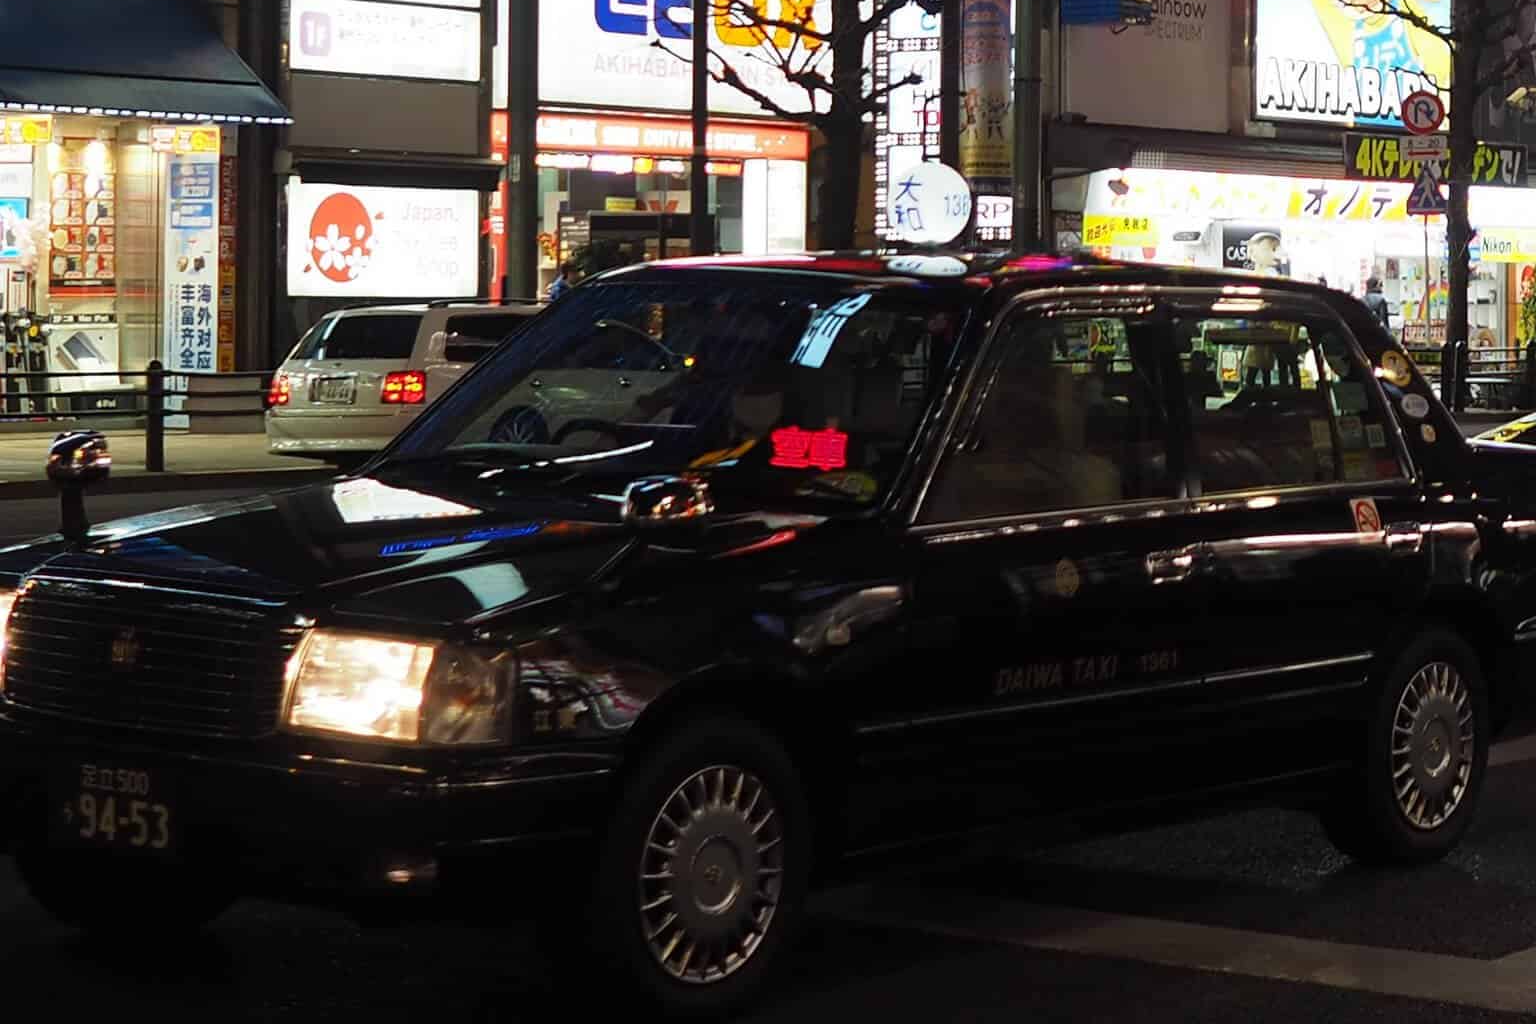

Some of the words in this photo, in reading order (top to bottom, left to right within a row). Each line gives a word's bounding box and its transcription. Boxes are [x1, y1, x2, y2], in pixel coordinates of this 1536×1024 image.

[593, 52, 697, 79] AKIHABA
[1482, 238, 1512, 254] Nikon
[197, 283, 212, 370] 海外对应
[79, 792, 169, 848] 94-53
